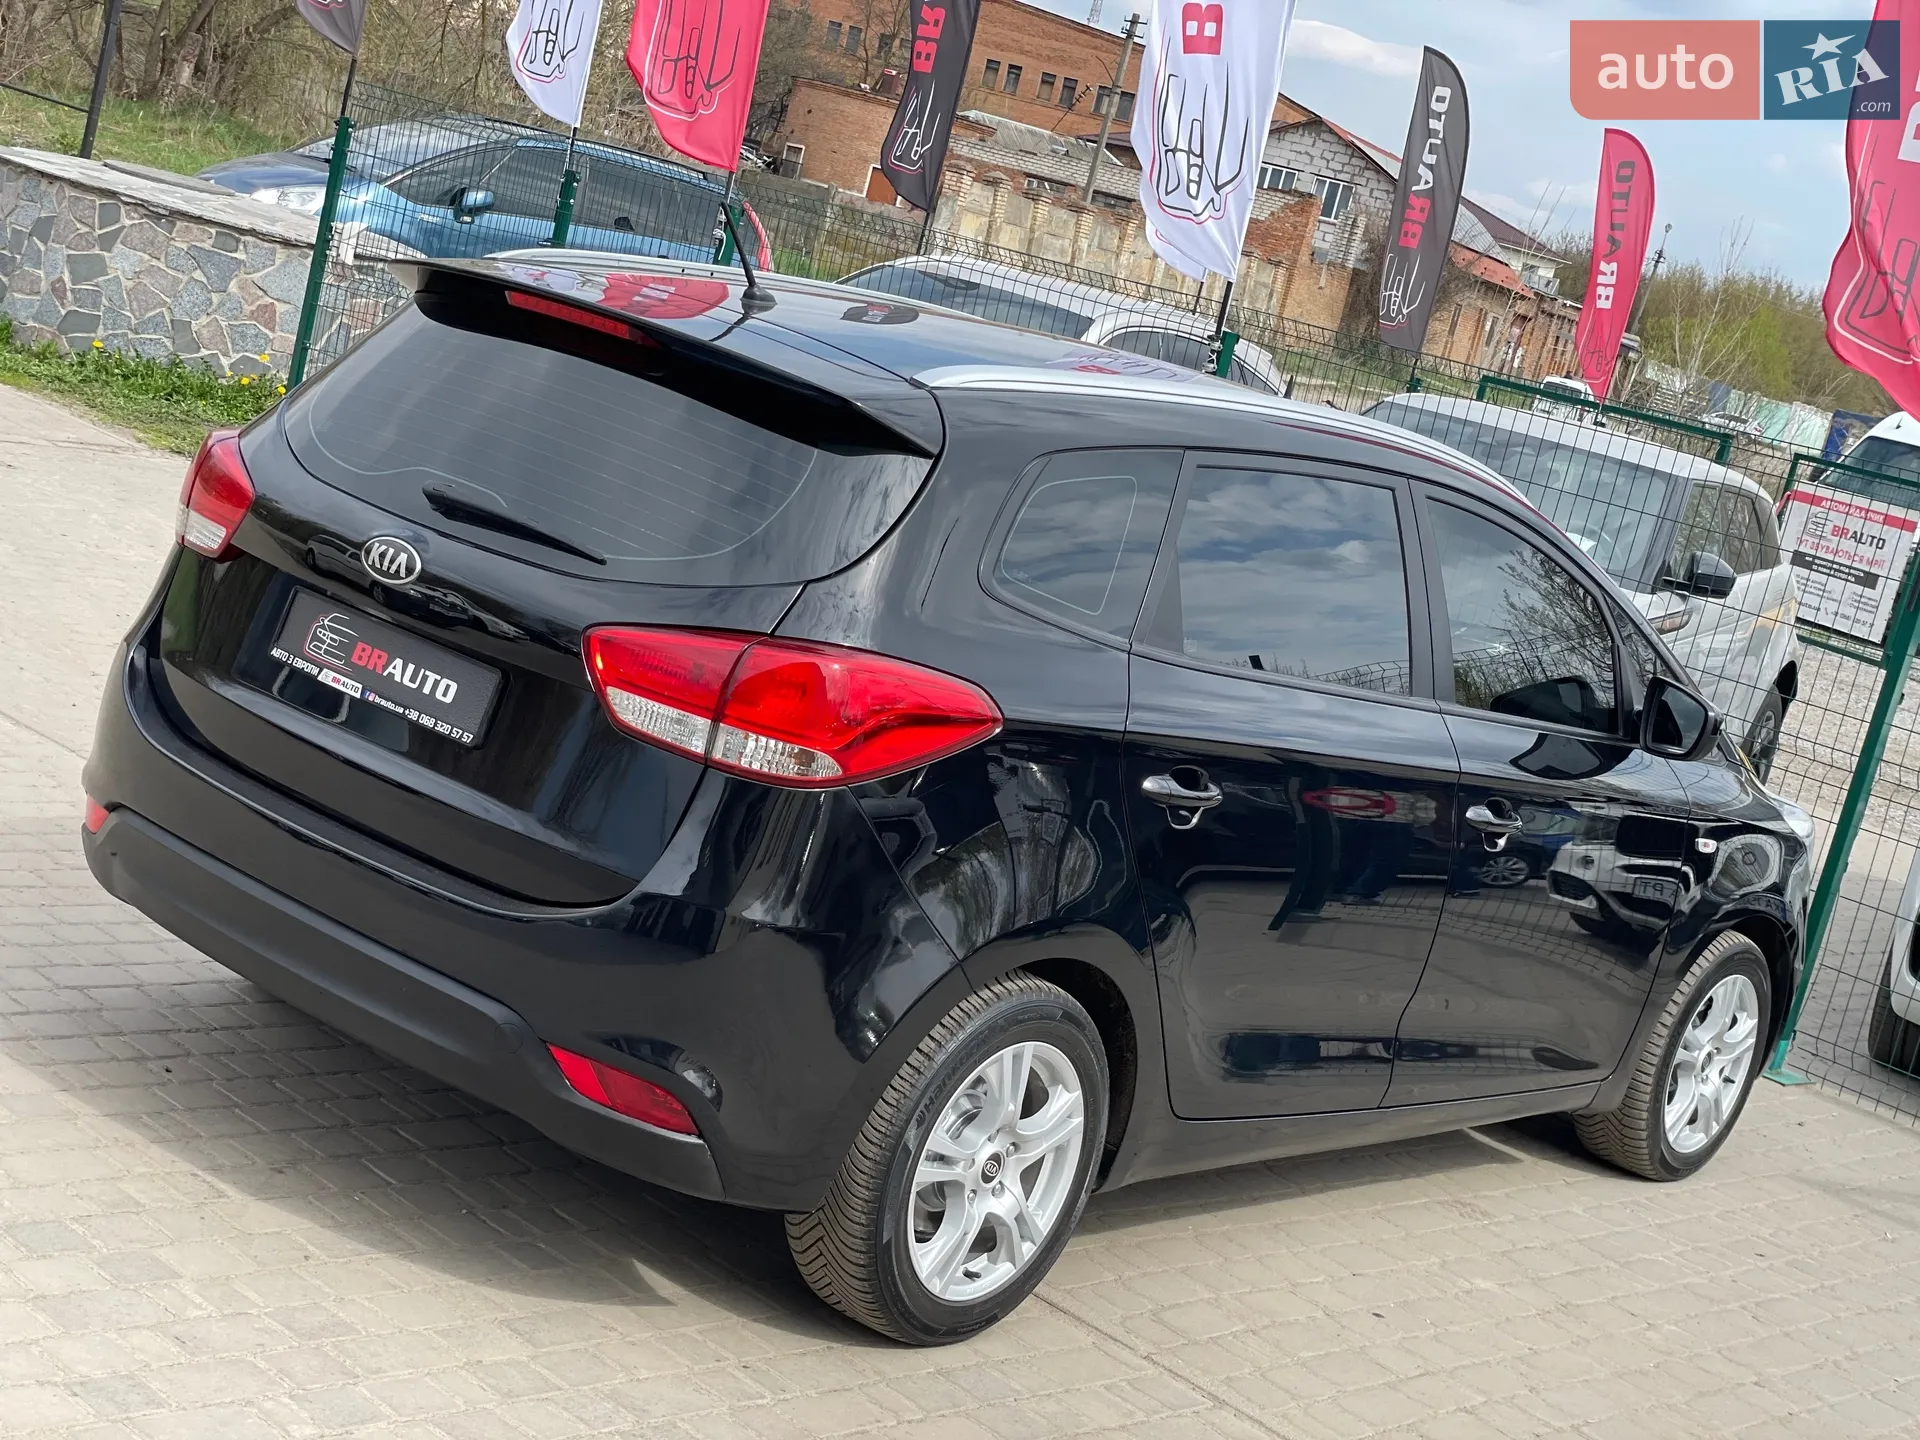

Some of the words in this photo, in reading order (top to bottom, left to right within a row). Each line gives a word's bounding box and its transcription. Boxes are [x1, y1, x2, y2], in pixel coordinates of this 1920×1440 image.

[1831, 524, 1886, 551] BRAUTO
[367, 542, 408, 579] KIA
[270, 647, 288, 661] АВТО
[331, 675, 360, 694] BRAUTO
[350, 641, 459, 704] BRAUTO
[374, 695, 404, 714] brauto.ua
[405, 708, 419, 721] +38
[419, 714, 436, 728] 068
[434, 720, 452, 735] 320
[450, 727, 462, 738] 57
[461, 731, 473, 744] 57
